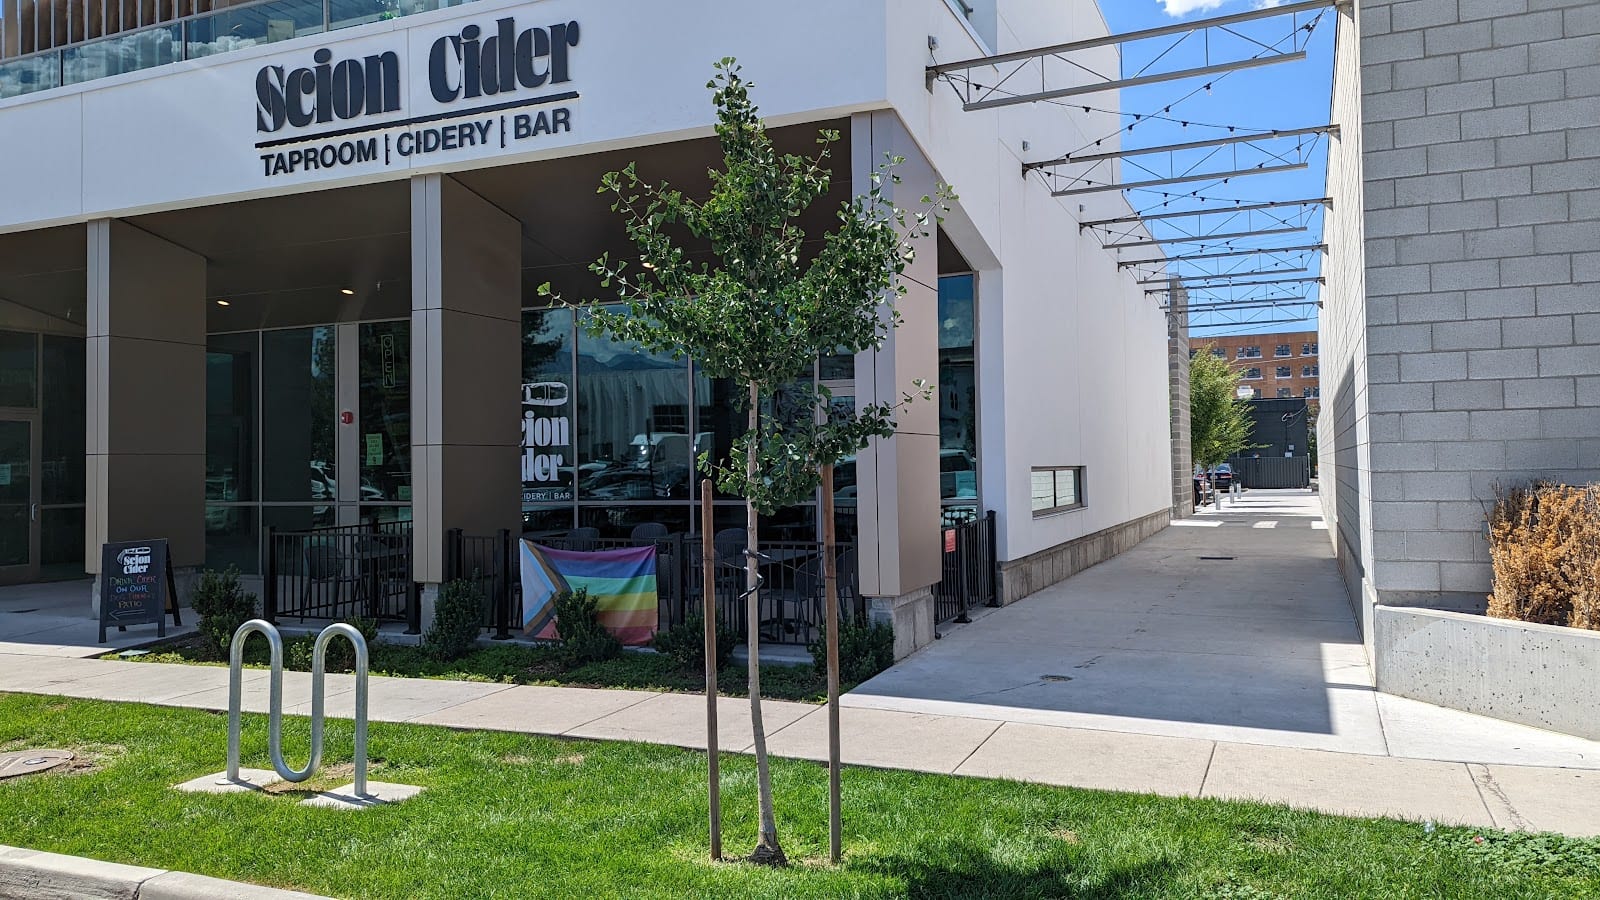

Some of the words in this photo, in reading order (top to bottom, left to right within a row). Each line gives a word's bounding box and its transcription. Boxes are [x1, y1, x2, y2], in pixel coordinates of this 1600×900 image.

[257, 48, 401, 133] Scion
[428, 16, 579, 104] Cider
[261, 138, 377, 177] TAPROOM
[397, 119, 493, 157] CIDERY
[514, 107, 571, 140] BAR
[383, 336, 394, 385] OPEN
[523, 492, 546, 500] IDERY
[123, 555, 151, 565] Scion
[123, 564, 149, 574] Cider
